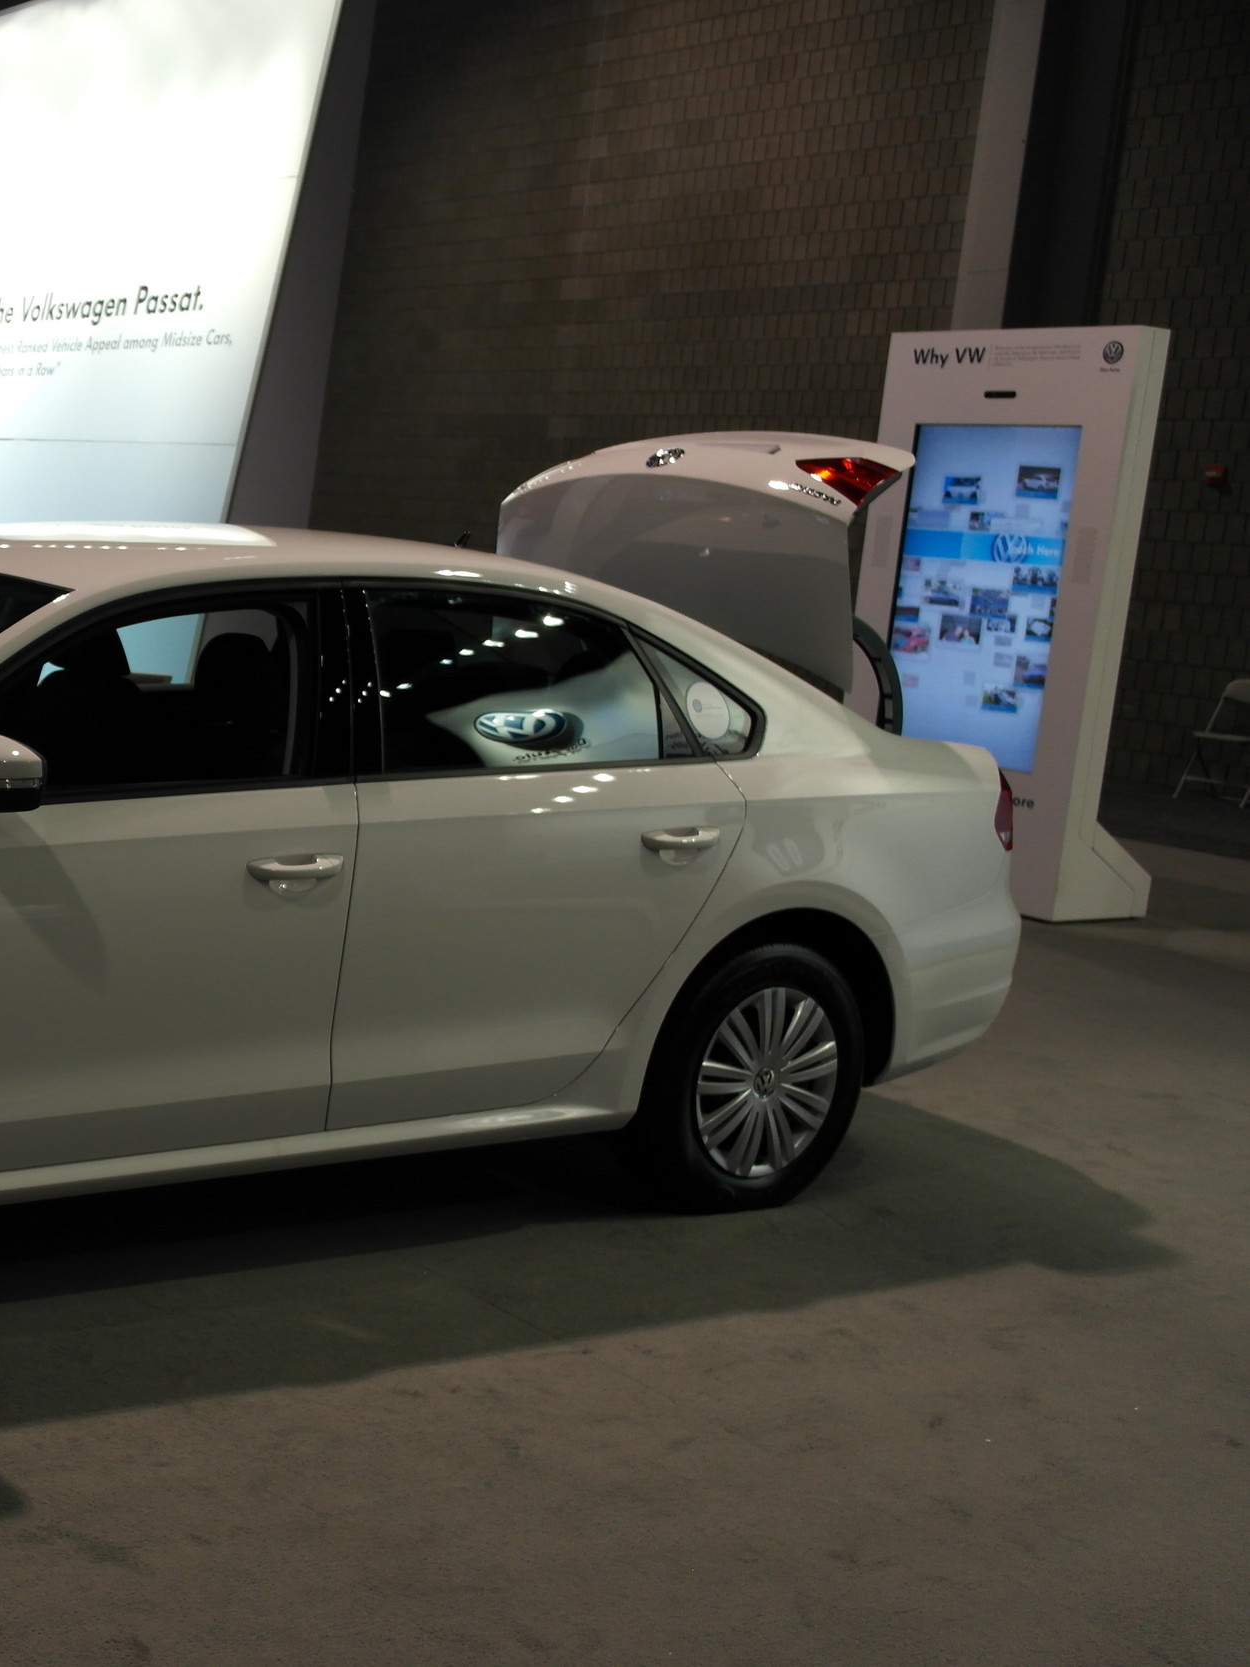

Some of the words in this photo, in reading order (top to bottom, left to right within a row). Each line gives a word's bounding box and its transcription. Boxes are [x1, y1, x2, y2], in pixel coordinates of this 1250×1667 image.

[23, 292, 127, 326] Volkswagen
[133, 285, 203, 315] Passat.
[52, 336, 82, 352] Vehicle
[85, 335, 121, 355] Appeal
[123, 338, 158, 353] among
[161, 330, 202, 348] Midsize
[206, 328, 232, 347] Cars,
[913, 347, 948, 368] Why
[955, 346, 986, 364] VW
[27, 367, 34, 377] a
